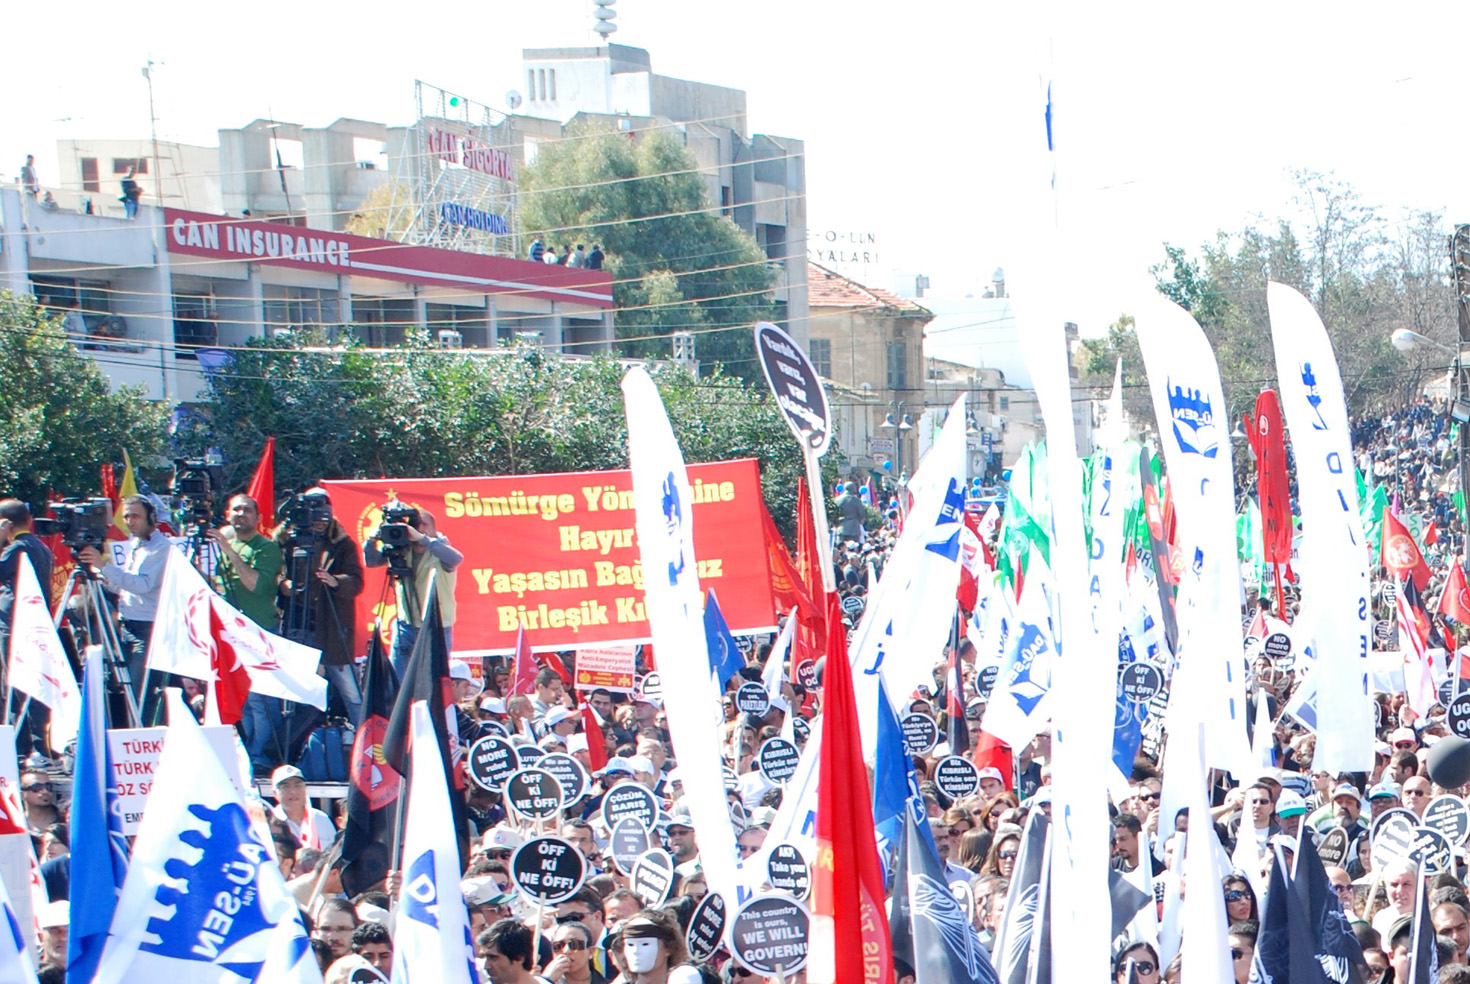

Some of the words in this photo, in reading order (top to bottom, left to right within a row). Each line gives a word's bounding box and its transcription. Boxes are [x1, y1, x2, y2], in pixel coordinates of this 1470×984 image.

[430, 126, 458, 164] CAN
[442, 202, 466, 225] CAN
[468, 207, 508, 235] HOLDING
[173, 217, 219, 250] CAN
[227, 226, 350, 267] INSURANCE
[444, 490, 575, 519] Sömürge
[473, 564, 588, 597] Yaşasın
[498, 602, 607, 633] Birleşik
[1268, 642, 1288, 650] more
[1134, 665, 1149, 675] ÖFF
[1137, 686, 1154, 695] ÖFF!
[482, 741, 498, 752] NO
[477, 749, 508, 764] MORE
[114, 760, 154, 775] TÜRK
[521, 773, 542, 784] ÖFF
[529, 784, 541, 795] Kİ
[516, 799, 532, 809] NE
[534, 797, 558, 808] ÖFF!
[610, 791, 646, 804] ÇÖZÜM,
[612, 800, 647, 812] BARIŞ
[1328, 834, 1341, 846] NO
[538, 841, 566, 856] ÖFF
[779, 847, 795, 860] AKP,
[541, 858, 557, 871] Kİ
[770, 861, 789, 873] Take
[790, 863, 806, 875] your
[519, 872, 539, 885] NE
[543, 874, 574, 889] ÖFF!
[712, 895, 723, 910] NO
[702, 905, 723, 928] MORE
[741, 910, 761, 920] This
[763, 906, 798, 918] country
[754, 920, 763, 929] is
[765, 919, 788, 929] ours,
[743, 932, 766, 945] WE
[768, 926, 804, 941] WILL
[744, 942, 808, 962] GOVERN!
